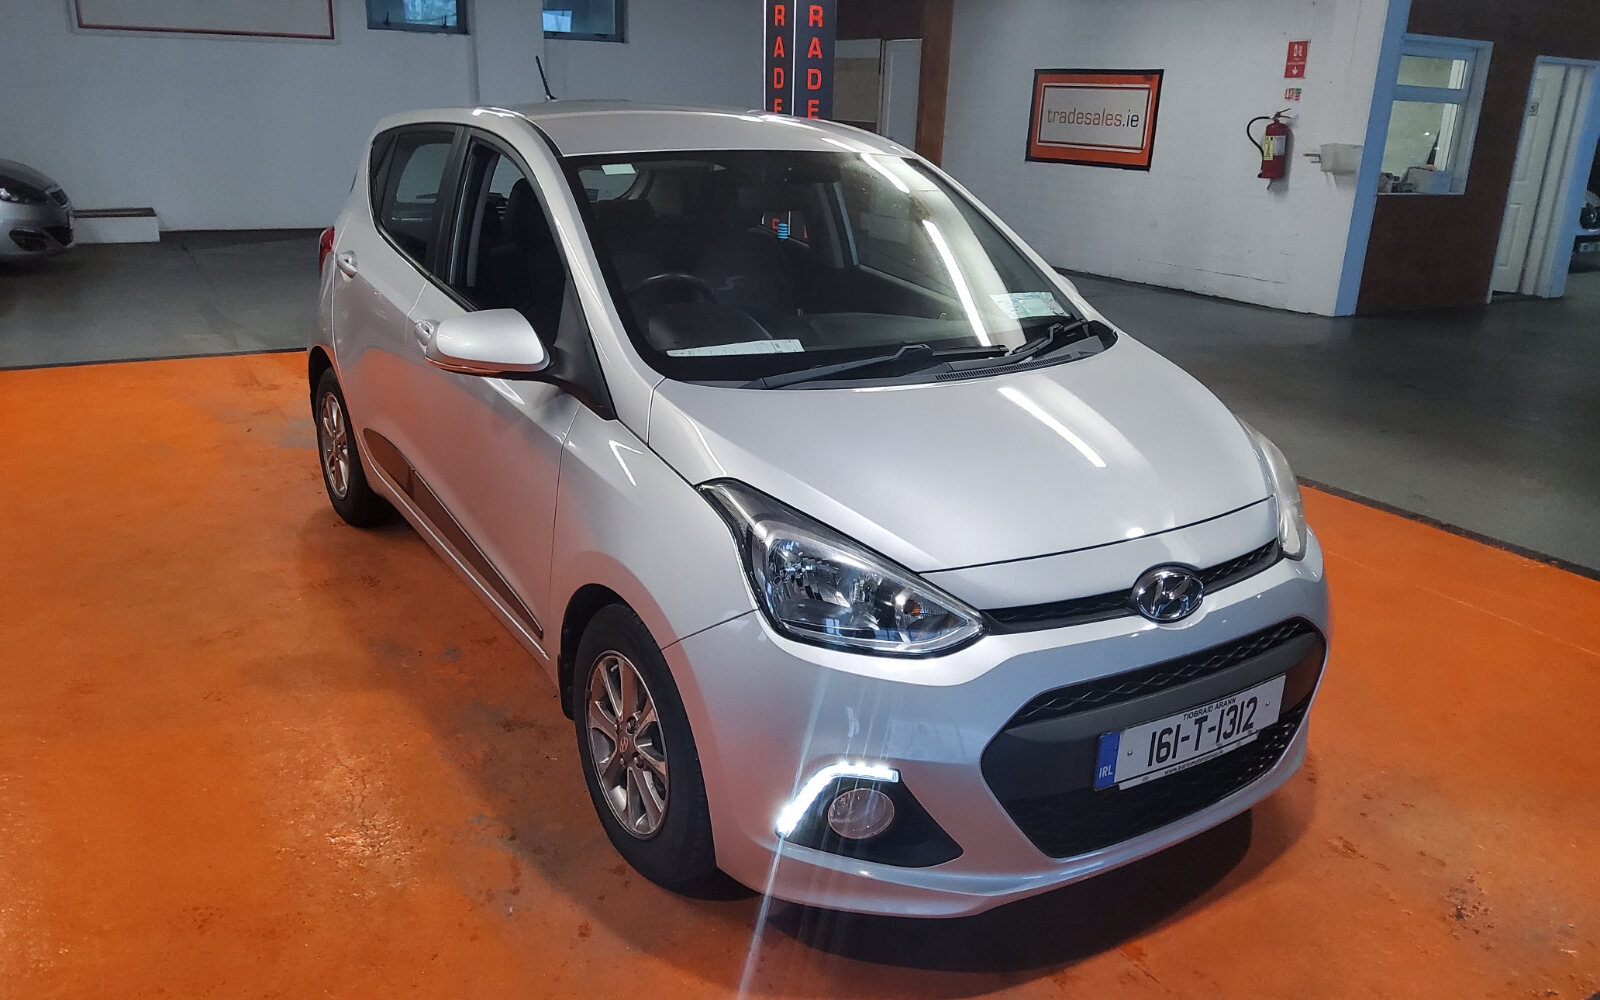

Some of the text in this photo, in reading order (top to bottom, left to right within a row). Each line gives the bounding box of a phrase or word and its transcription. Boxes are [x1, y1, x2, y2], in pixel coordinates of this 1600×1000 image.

[807, 5, 823, 119] RADE
[1047, 107, 1140, 128] tradesales.ie
[1183, 705, 1214, 720] TIOBRAID
[1147, 696, 1258, 768] 161-T-1312
[1099, 764, 1113, 779] IRL
